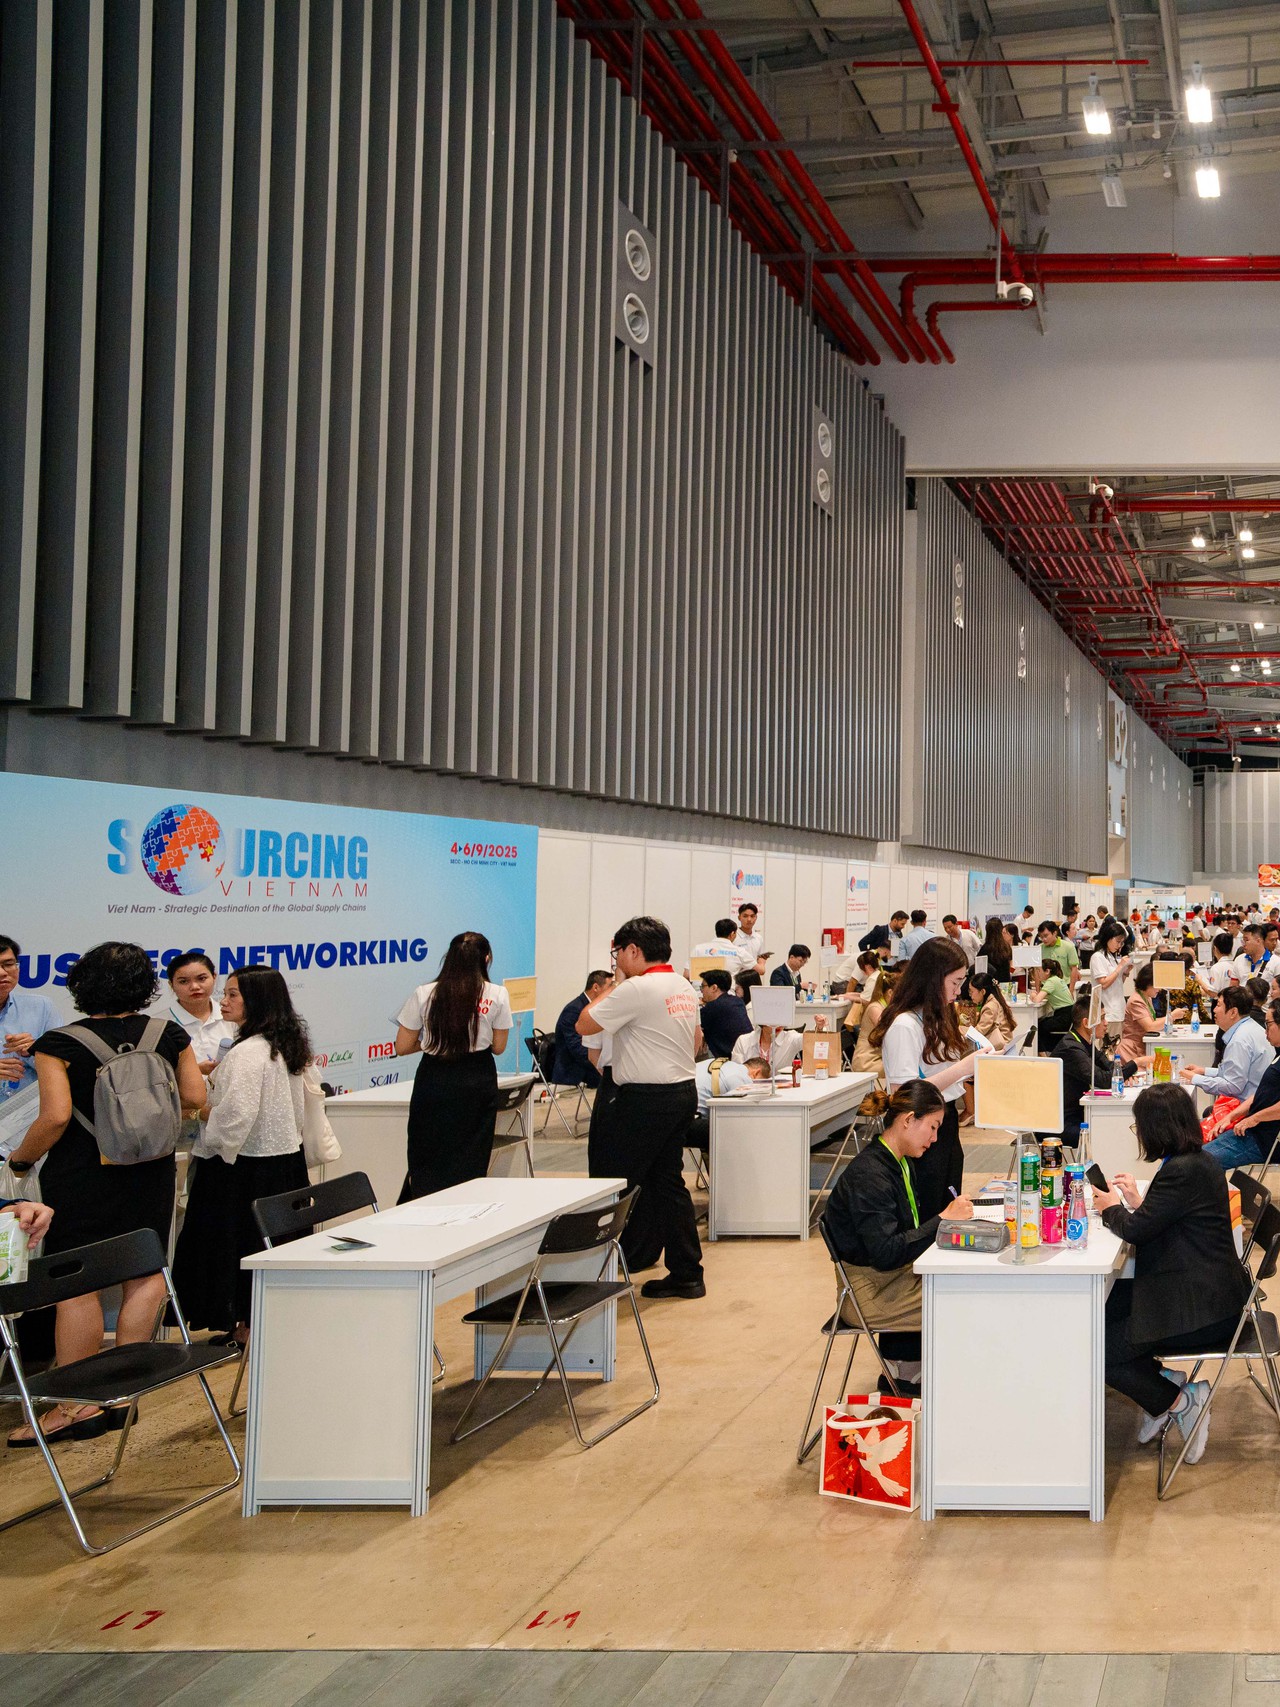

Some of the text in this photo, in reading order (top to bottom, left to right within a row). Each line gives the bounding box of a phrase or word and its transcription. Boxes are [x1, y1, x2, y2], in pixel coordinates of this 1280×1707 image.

[220, 880, 368, 897] VIETNAM
[107, 904, 128, 914] Viet
[130, 904, 156, 914] Nam
[164, 904, 208, 916] Strategic
[209, 903, 260, 913] Destination
[262, 903, 271, 913] of
[271, 903, 285, 912] the
[287, 903, 315, 912] Global
[315, 903, 340, 914] Supply
[341, 903, 367, 912] Chains
[368, 1042, 398, 1059] ma
